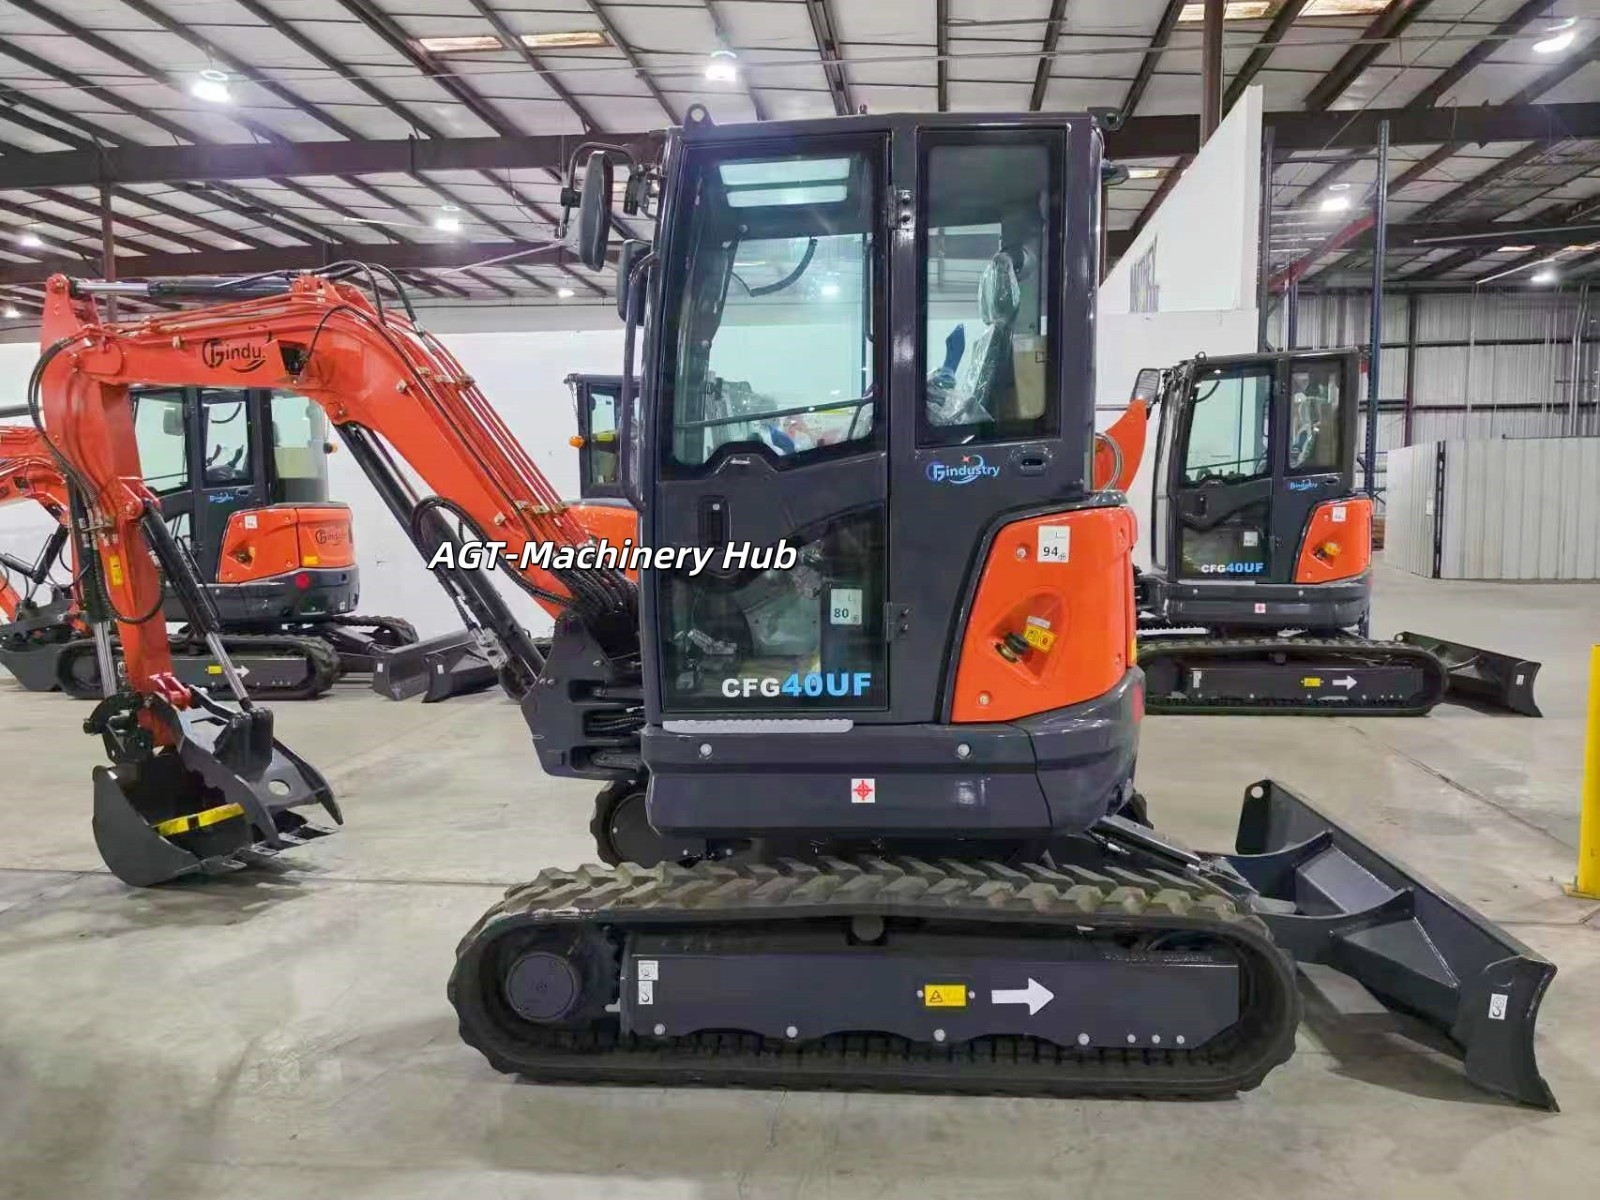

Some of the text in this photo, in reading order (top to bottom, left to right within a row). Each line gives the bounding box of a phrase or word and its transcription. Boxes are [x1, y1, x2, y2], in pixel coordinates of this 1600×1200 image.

[1043, 546, 1059, 557] 94
[1200, 562, 1264, 573] CFG40UF
[833, 608, 849, 618] 80
[722, 672, 871, 697] CFG40UF
